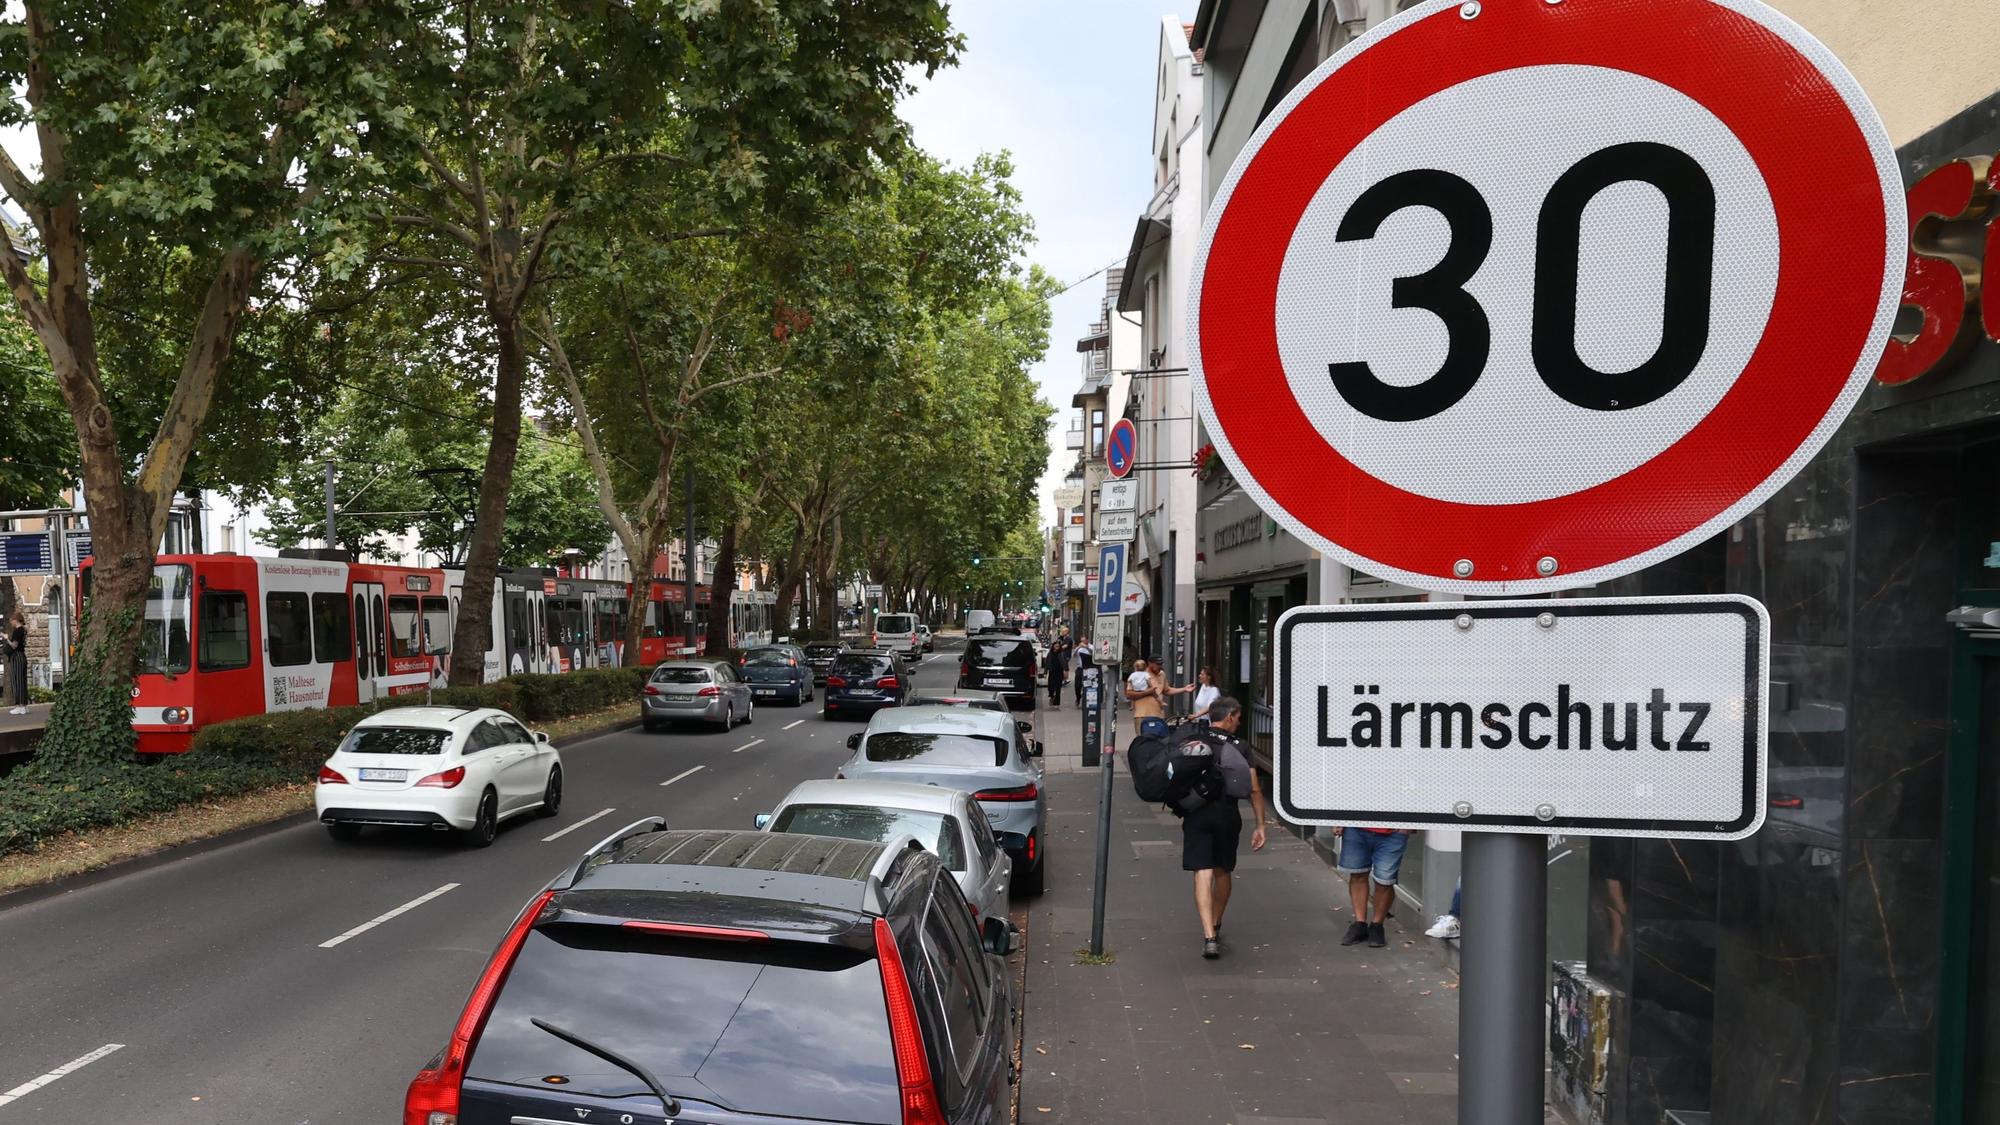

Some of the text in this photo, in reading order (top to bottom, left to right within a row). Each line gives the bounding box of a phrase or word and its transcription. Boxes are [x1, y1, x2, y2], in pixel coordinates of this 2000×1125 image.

[1328, 141, 1716, 422] 30
[1102, 551, 1118, 603] P
[288, 675, 316, 689] Malteser
[288, 687, 325, 704] Hausnotruf
[1318, 685, 1711, 752] Lärmschutz
